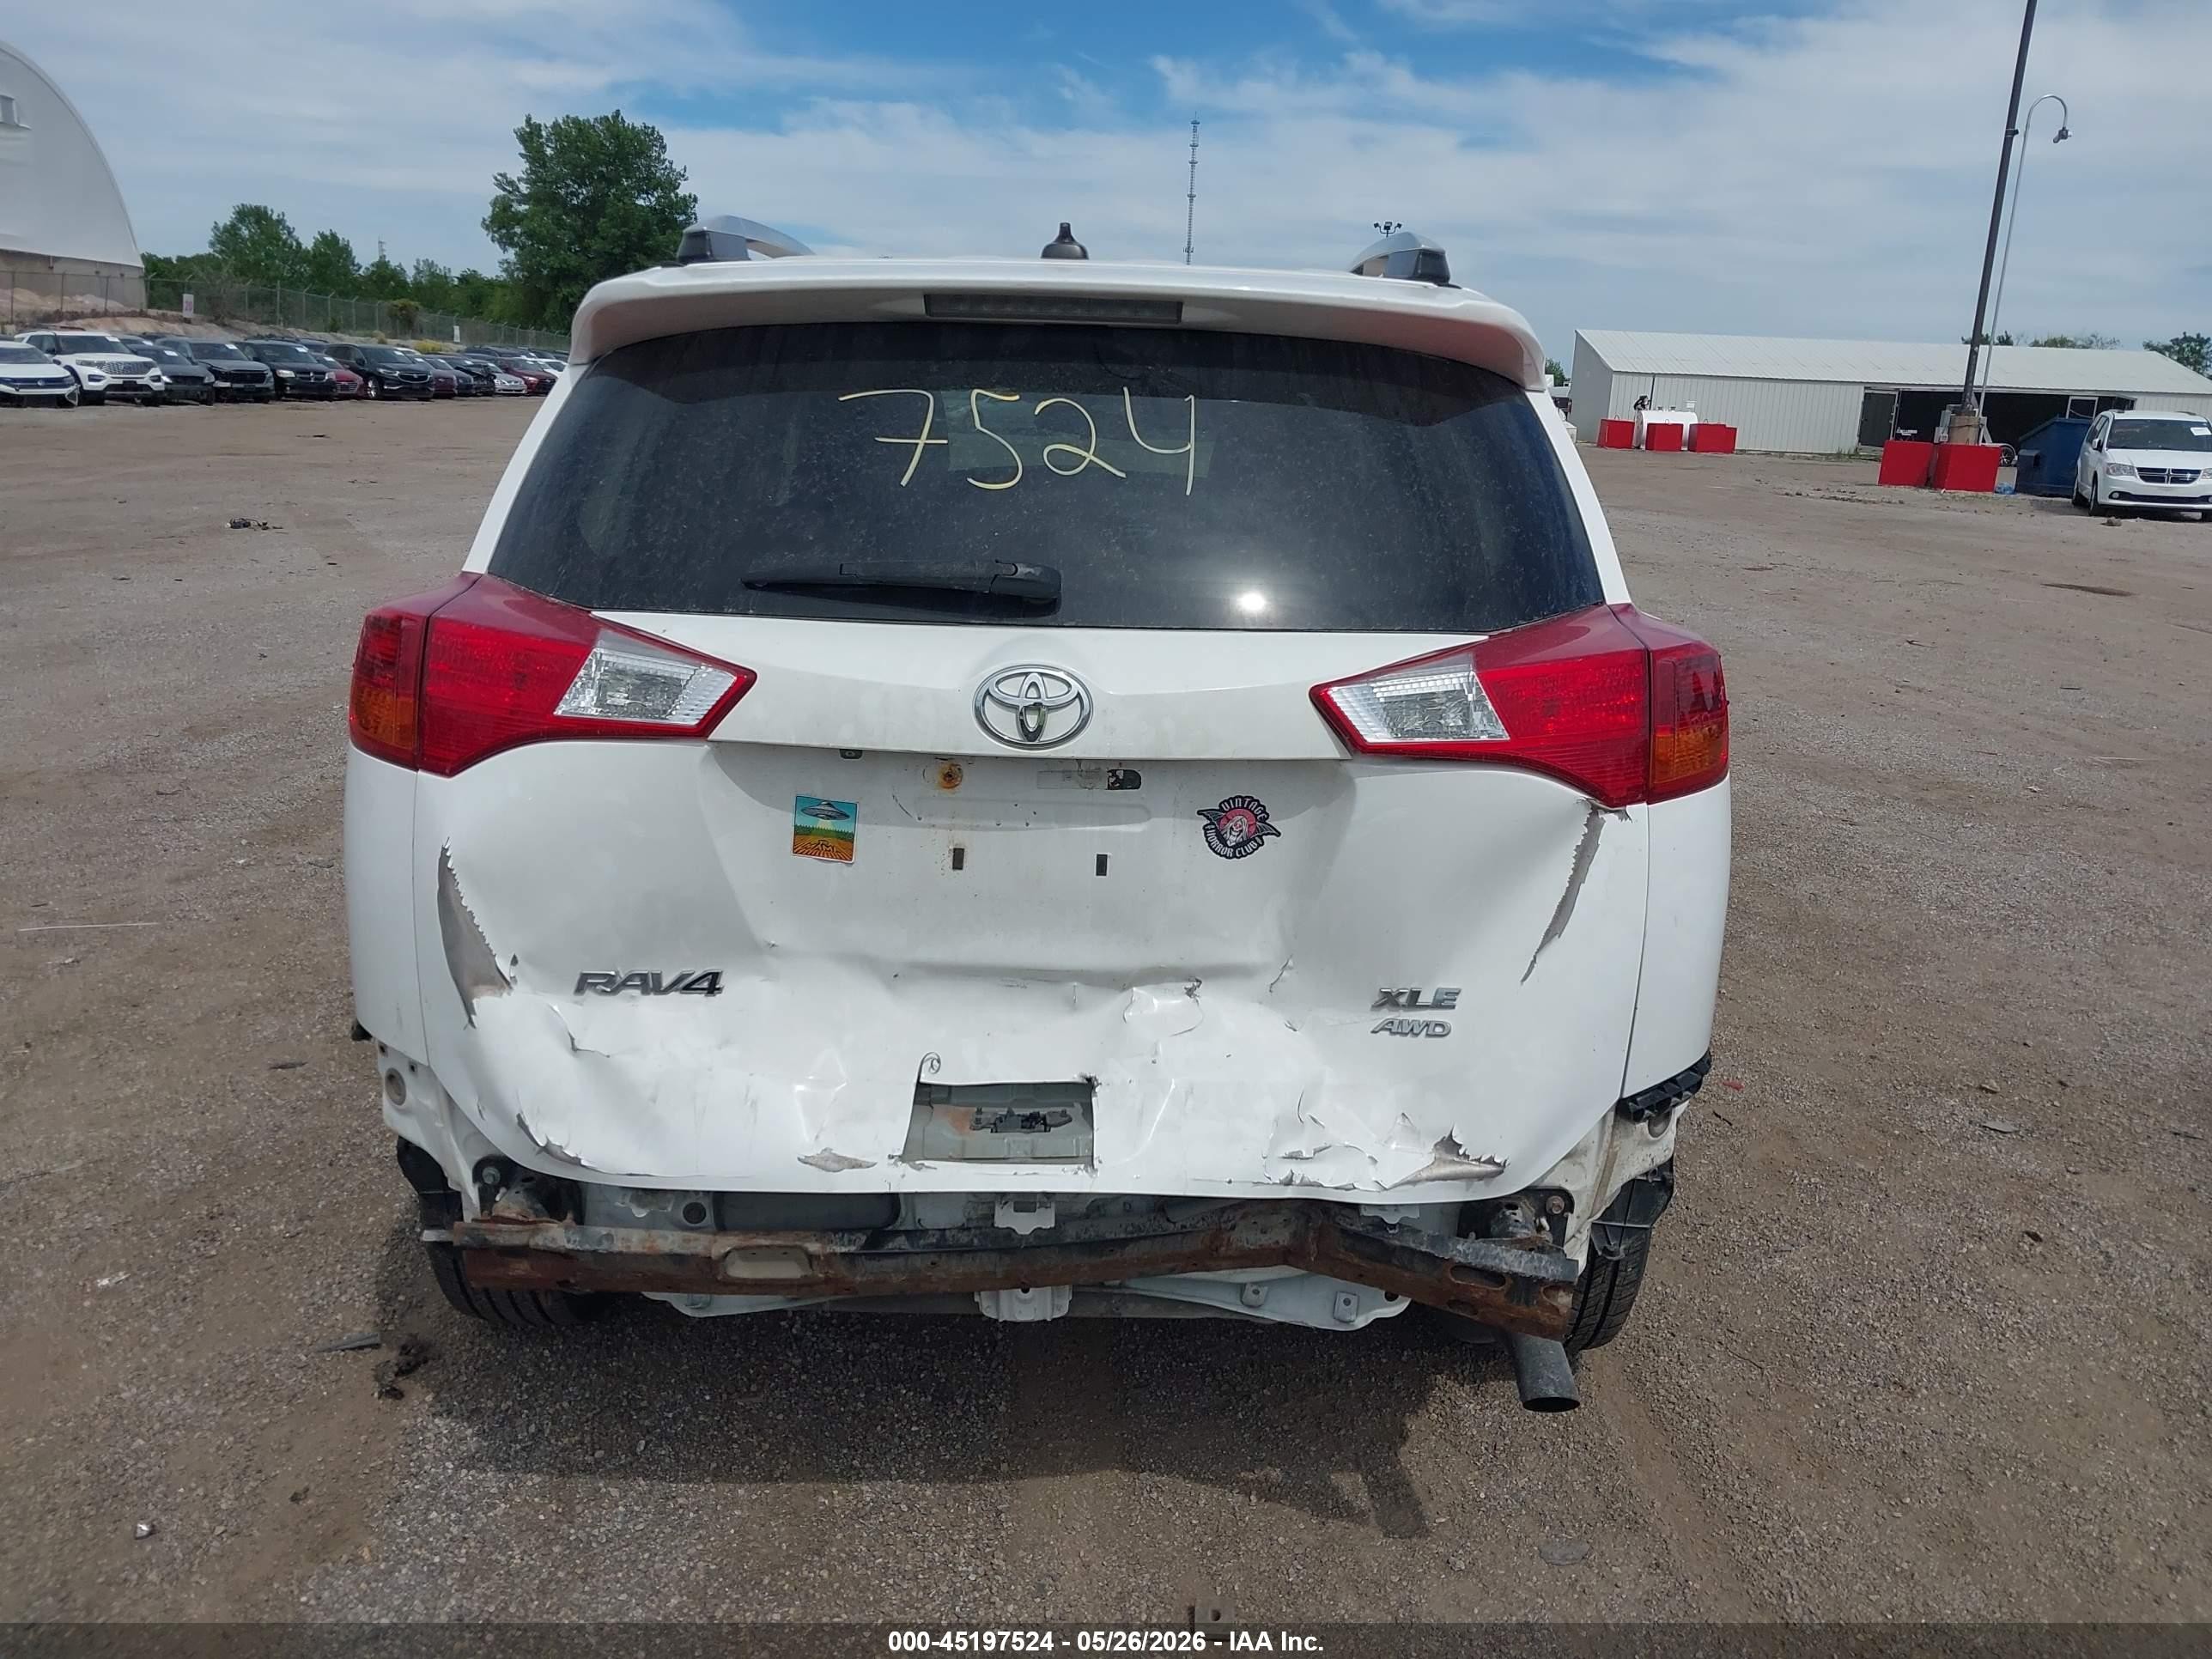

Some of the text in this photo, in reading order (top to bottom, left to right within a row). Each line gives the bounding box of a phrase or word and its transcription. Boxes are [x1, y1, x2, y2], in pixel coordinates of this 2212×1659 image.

[838, 386, 1196, 495] 7524
[1221, 798, 1267, 821] VINTAGE
[1206, 830, 1259, 858] HORROR CLUB
[574, 969, 725, 997] RAV4
[1370, 988, 1462, 1012] XLE
[1370, 1018, 1452, 1037] AWD
